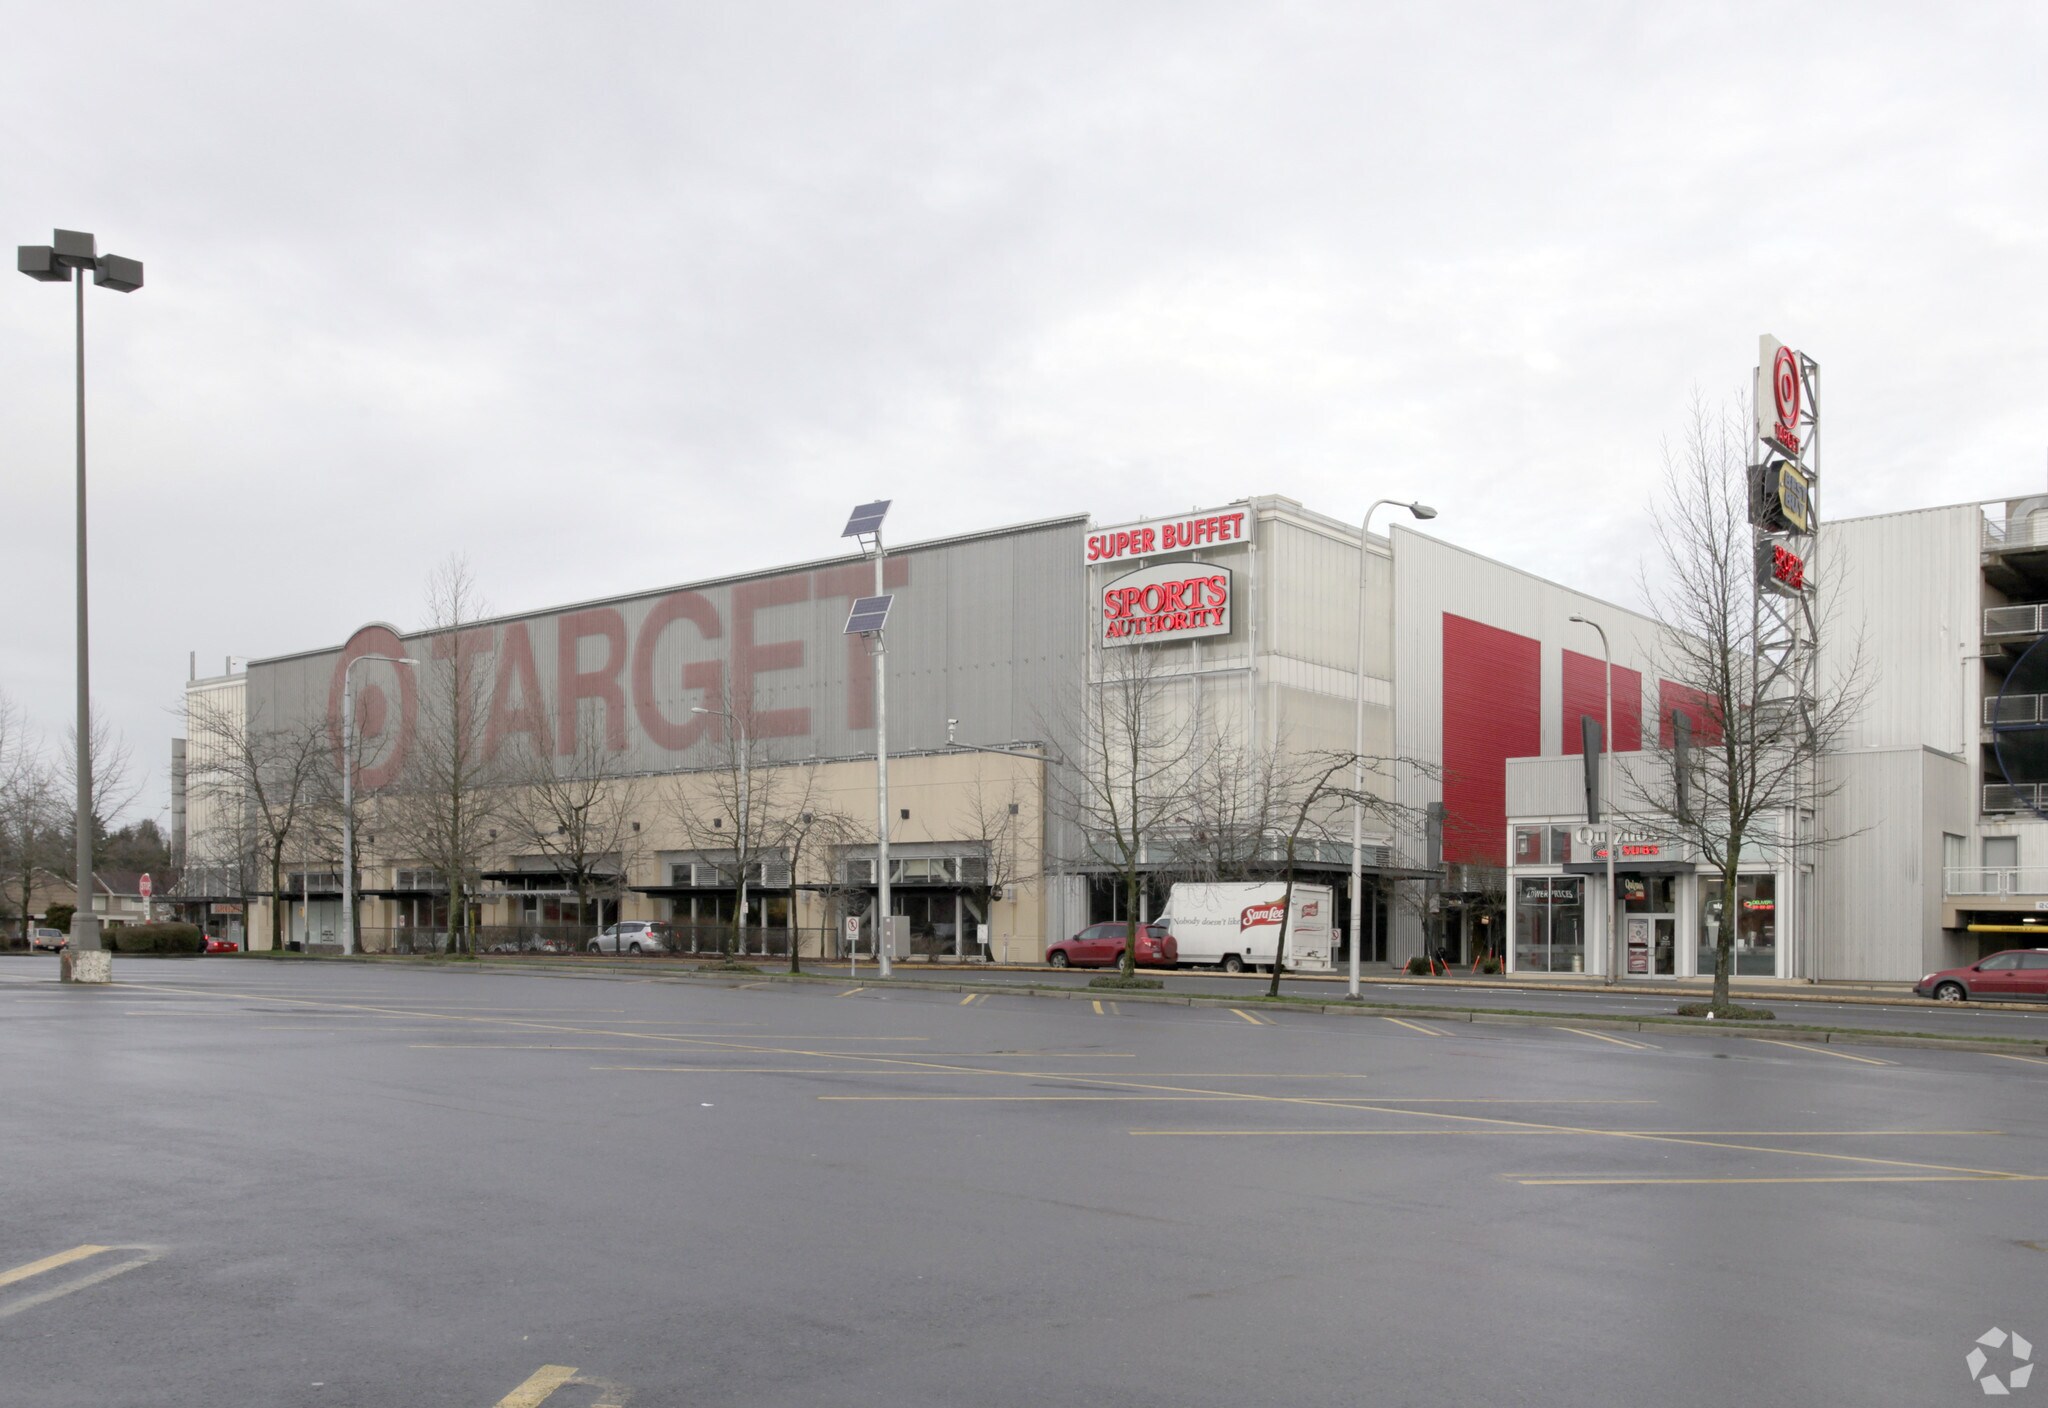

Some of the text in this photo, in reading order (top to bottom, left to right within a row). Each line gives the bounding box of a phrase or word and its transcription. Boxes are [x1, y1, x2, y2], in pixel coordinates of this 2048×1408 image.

[1784, 470, 1807, 504] BEST
[1784, 488, 1805, 518] BUY
[1087, 513, 1244, 561] SUPER BUFFET
[1104, 575, 1226, 619] SPORTS
[1105, 607, 1225, 638] AUTHORITY
[431, 557, 909, 765] TARGET
[1622, 845, 1659, 856] SUBS
[1526, 890, 1573, 898] LOWER PRICES
[1174, 917, 1241, 926] Nobody doesn't like
[1243, 906, 1284, 926] Sara Lee
